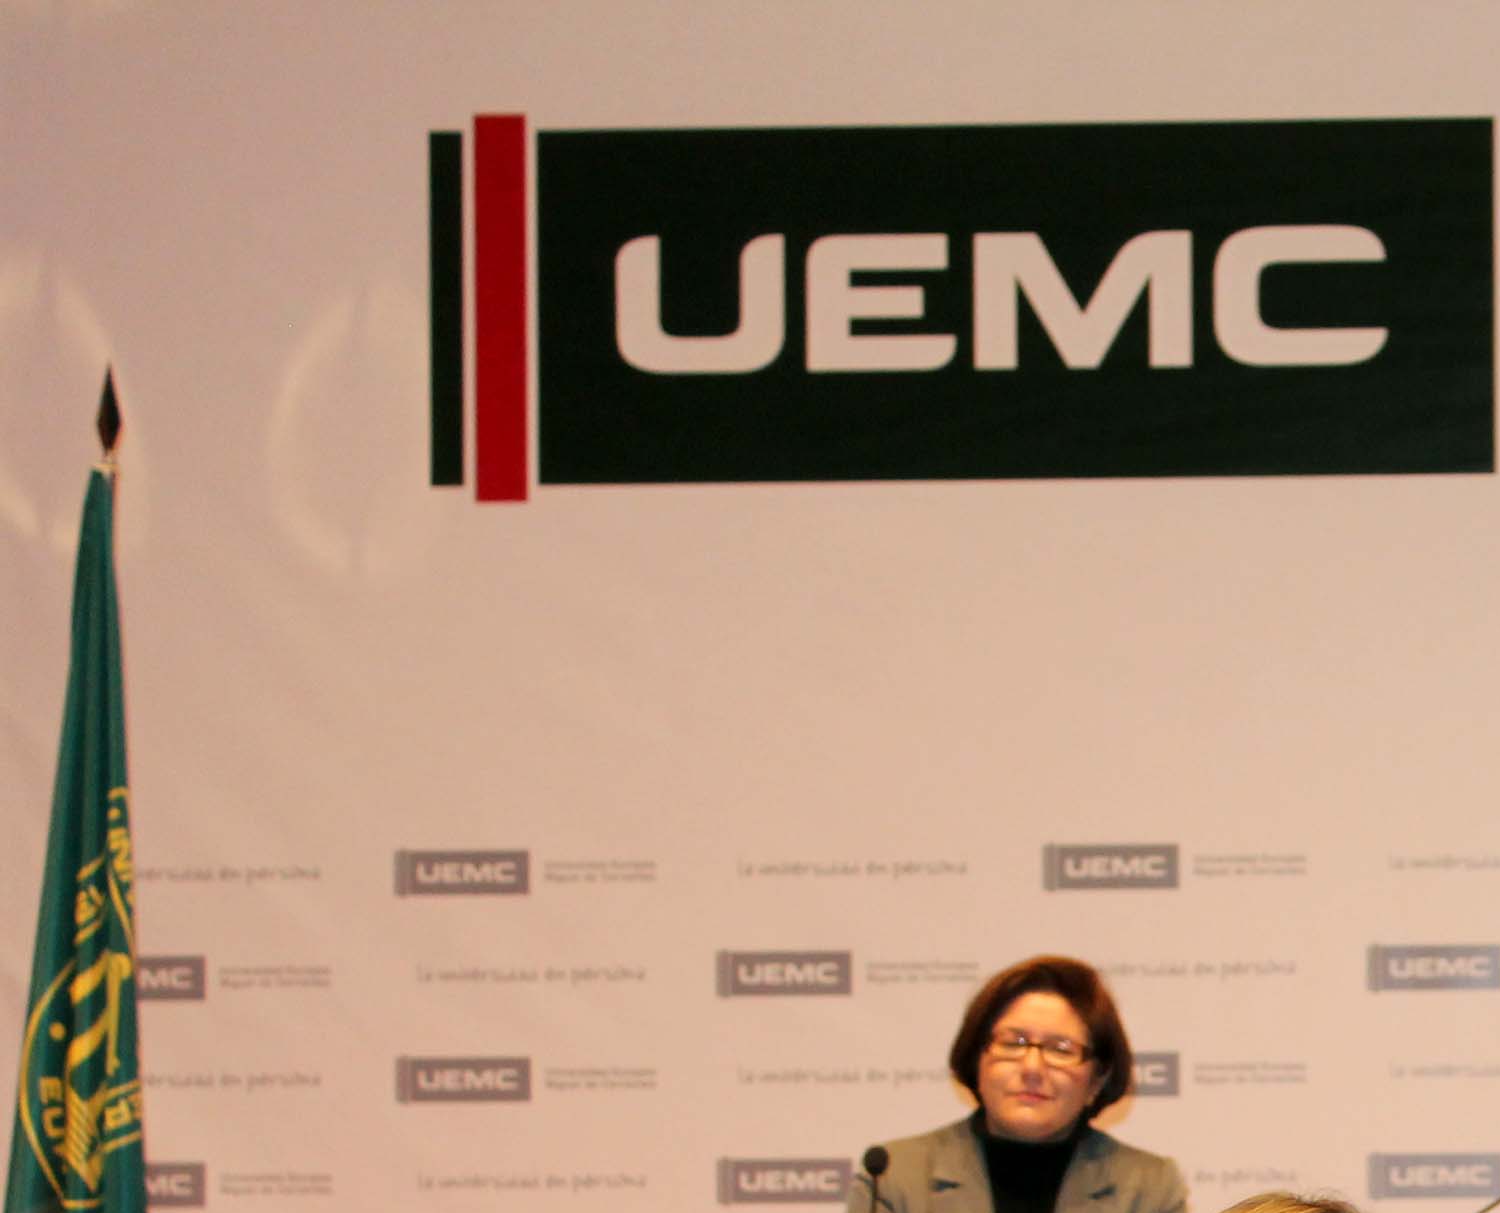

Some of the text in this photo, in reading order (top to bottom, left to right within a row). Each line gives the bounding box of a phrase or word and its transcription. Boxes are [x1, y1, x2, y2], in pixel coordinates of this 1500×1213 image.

[615, 224, 1388, 375] UEMC
[416, 861, 516, 884] UEMC
[1064, 855, 1166, 878] UEMC
[137, 967, 193, 990] MC
[738, 962, 838, 985] UEMC
[1389, 957, 1492, 980] UEMC
[417, 1068, 518, 1091] UEMC
[739, 1169, 840, 1193] UEMC
[1390, 1164, 1492, 1187] UEMC
